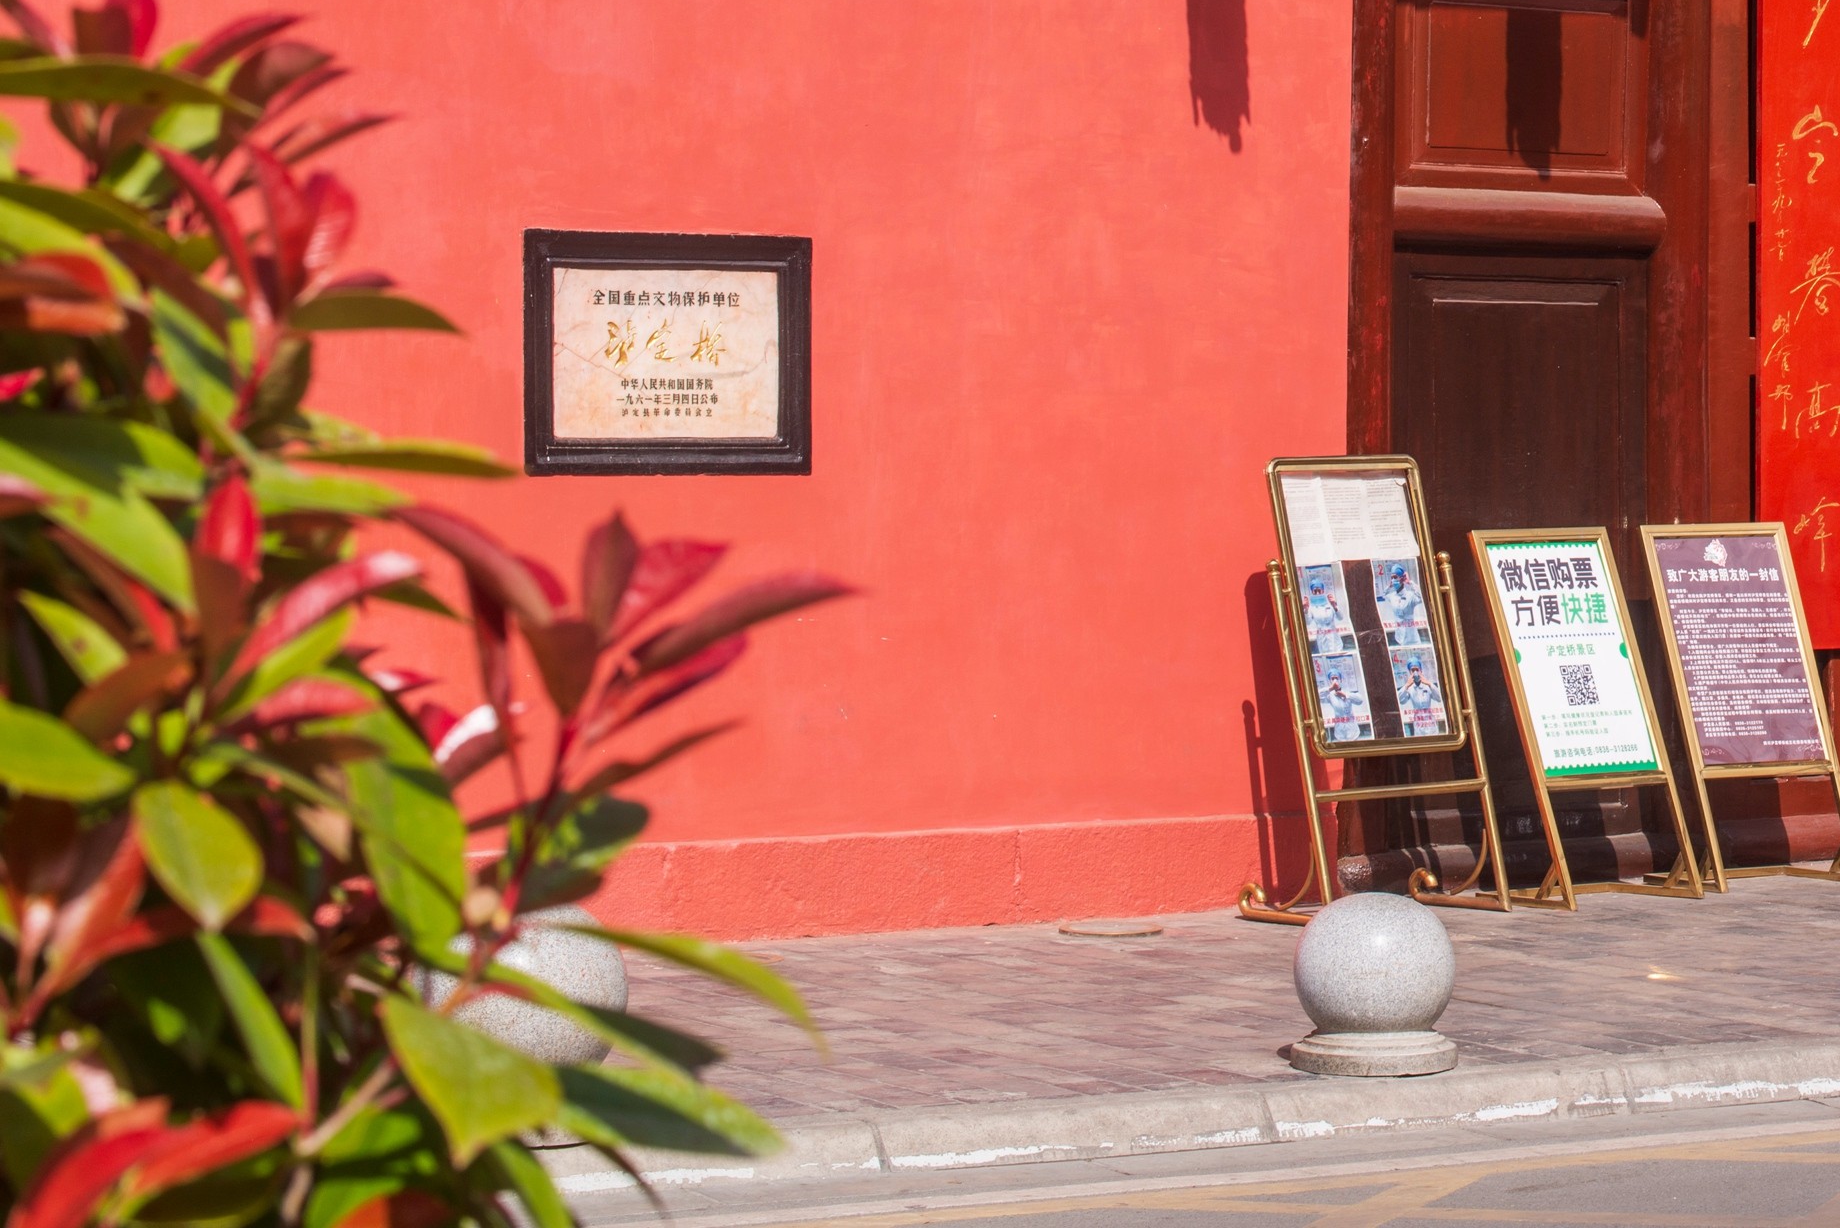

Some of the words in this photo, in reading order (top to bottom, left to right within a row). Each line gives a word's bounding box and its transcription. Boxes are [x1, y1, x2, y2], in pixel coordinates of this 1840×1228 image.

[592, 289, 741, 308] 全国重点文物保护单位
[620, 378, 714, 391] 中华人民共和国国务院
[616, 393, 719, 406] 一九六一年三月四日公布
[1377, 564, 1384, 576] 2
[1498, 557, 1599, 592] 微信购票
[1666, 568, 1780, 582] 致广大游客朋友的一封信
[1511, 592, 1609, 627] 方便快捷
[1546, 643, 1596, 656] 泸定桥景区
